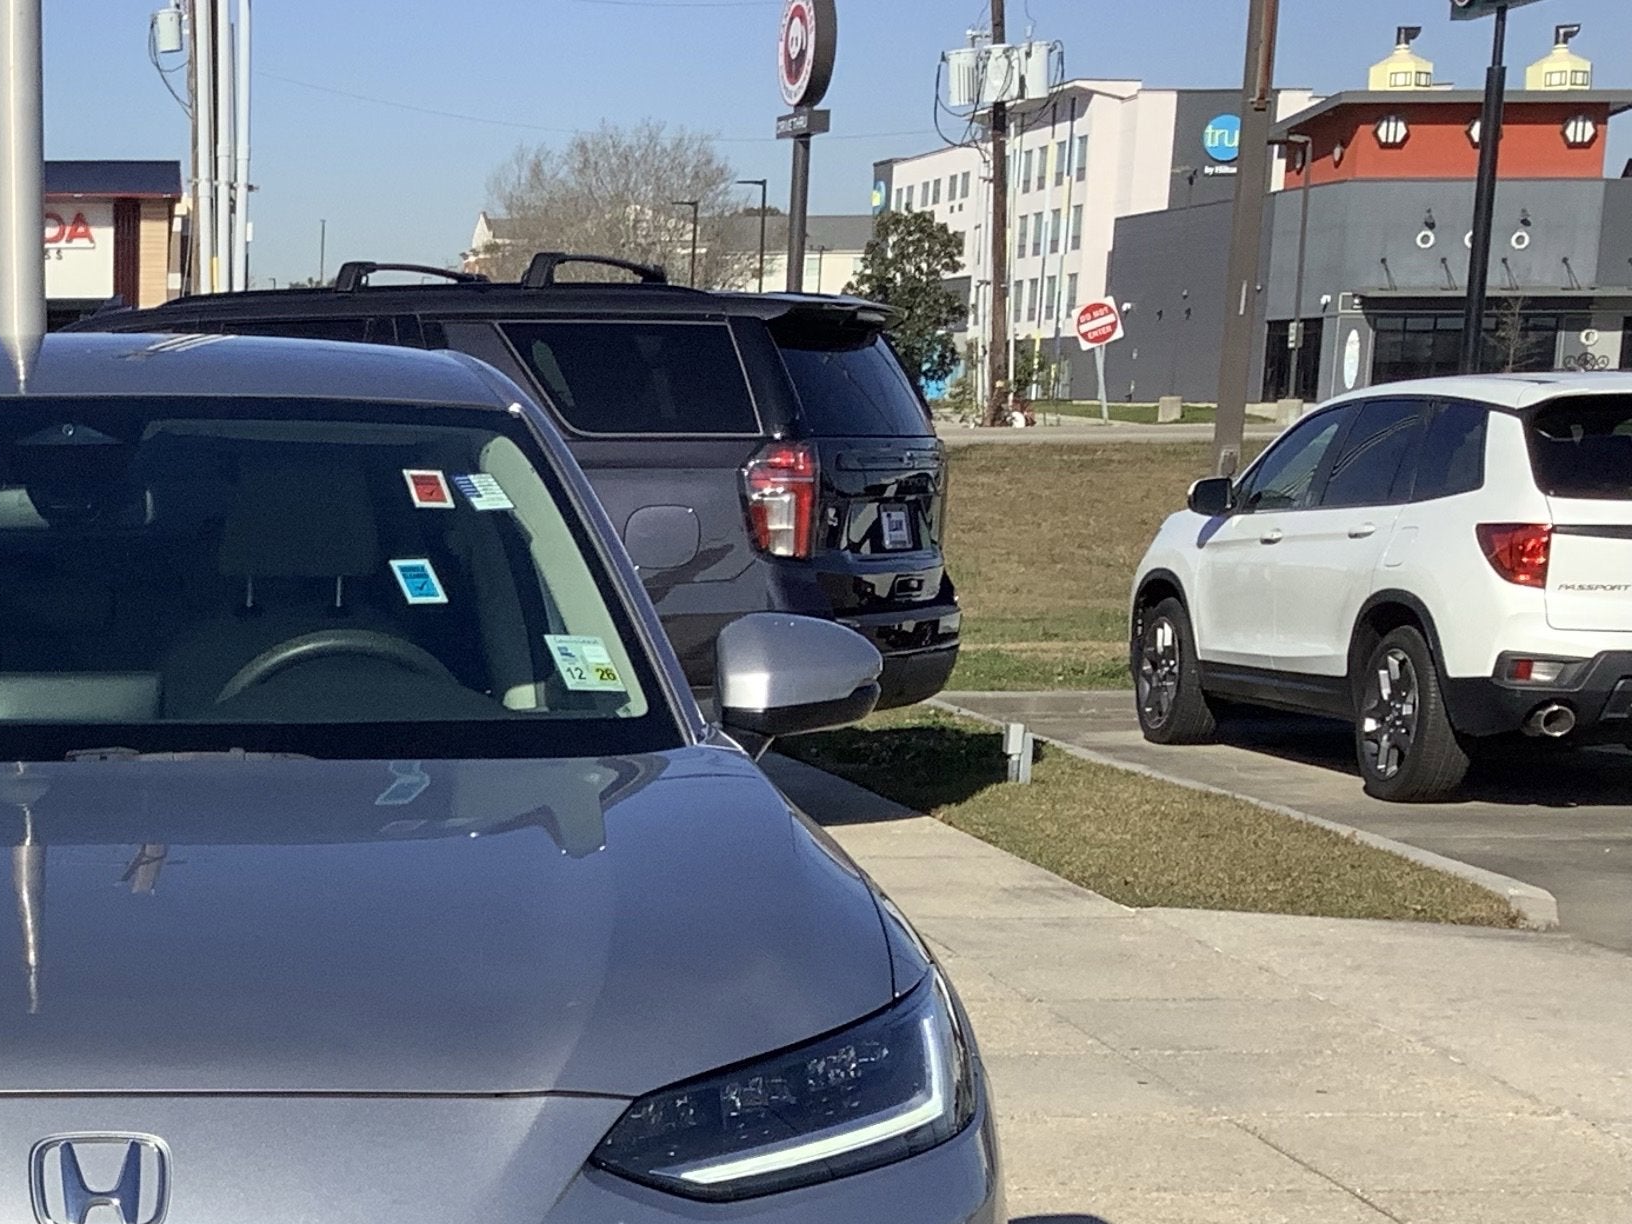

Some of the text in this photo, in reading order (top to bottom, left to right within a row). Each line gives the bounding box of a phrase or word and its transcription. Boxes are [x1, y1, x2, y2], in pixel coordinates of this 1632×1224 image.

[1204, 124, 1239, 148] tru
[1079, 306, 1109, 323] DO NOT
[1087, 325, 1112, 339] ENTER
[1557, 583, 1632, 592] PASSPORT
[566, 667, 618, 681] 12 26
